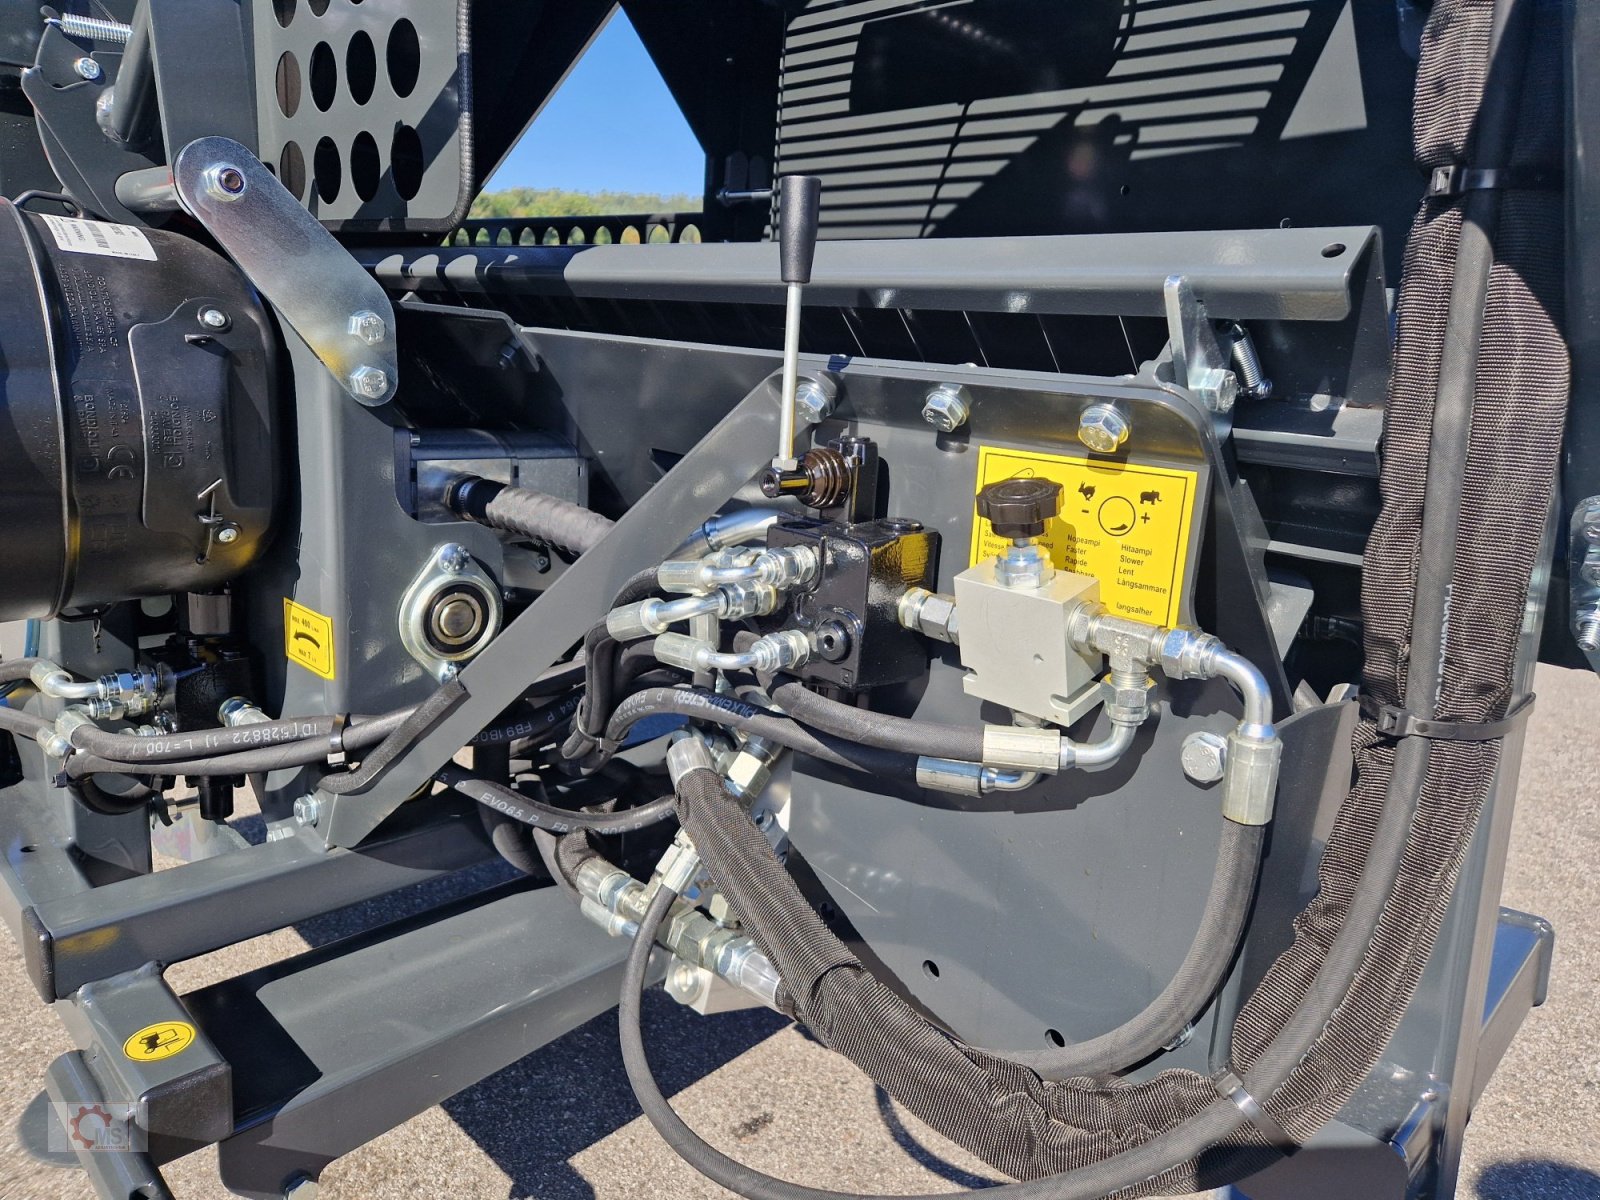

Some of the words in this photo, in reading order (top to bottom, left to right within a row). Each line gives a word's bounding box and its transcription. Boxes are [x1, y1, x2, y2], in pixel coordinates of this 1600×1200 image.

[1067, 534, 1100, 547] Nopeampi
[1066, 545, 1086, 556] Faster
[1121, 544, 1152, 557] Hitaampi
[1065, 556, 1088, 566] Rapide
[1120, 555, 1144, 566] Slower
[1119, 567, 1134, 576] Lent
[1117, 578, 1167, 594] Långsammare
